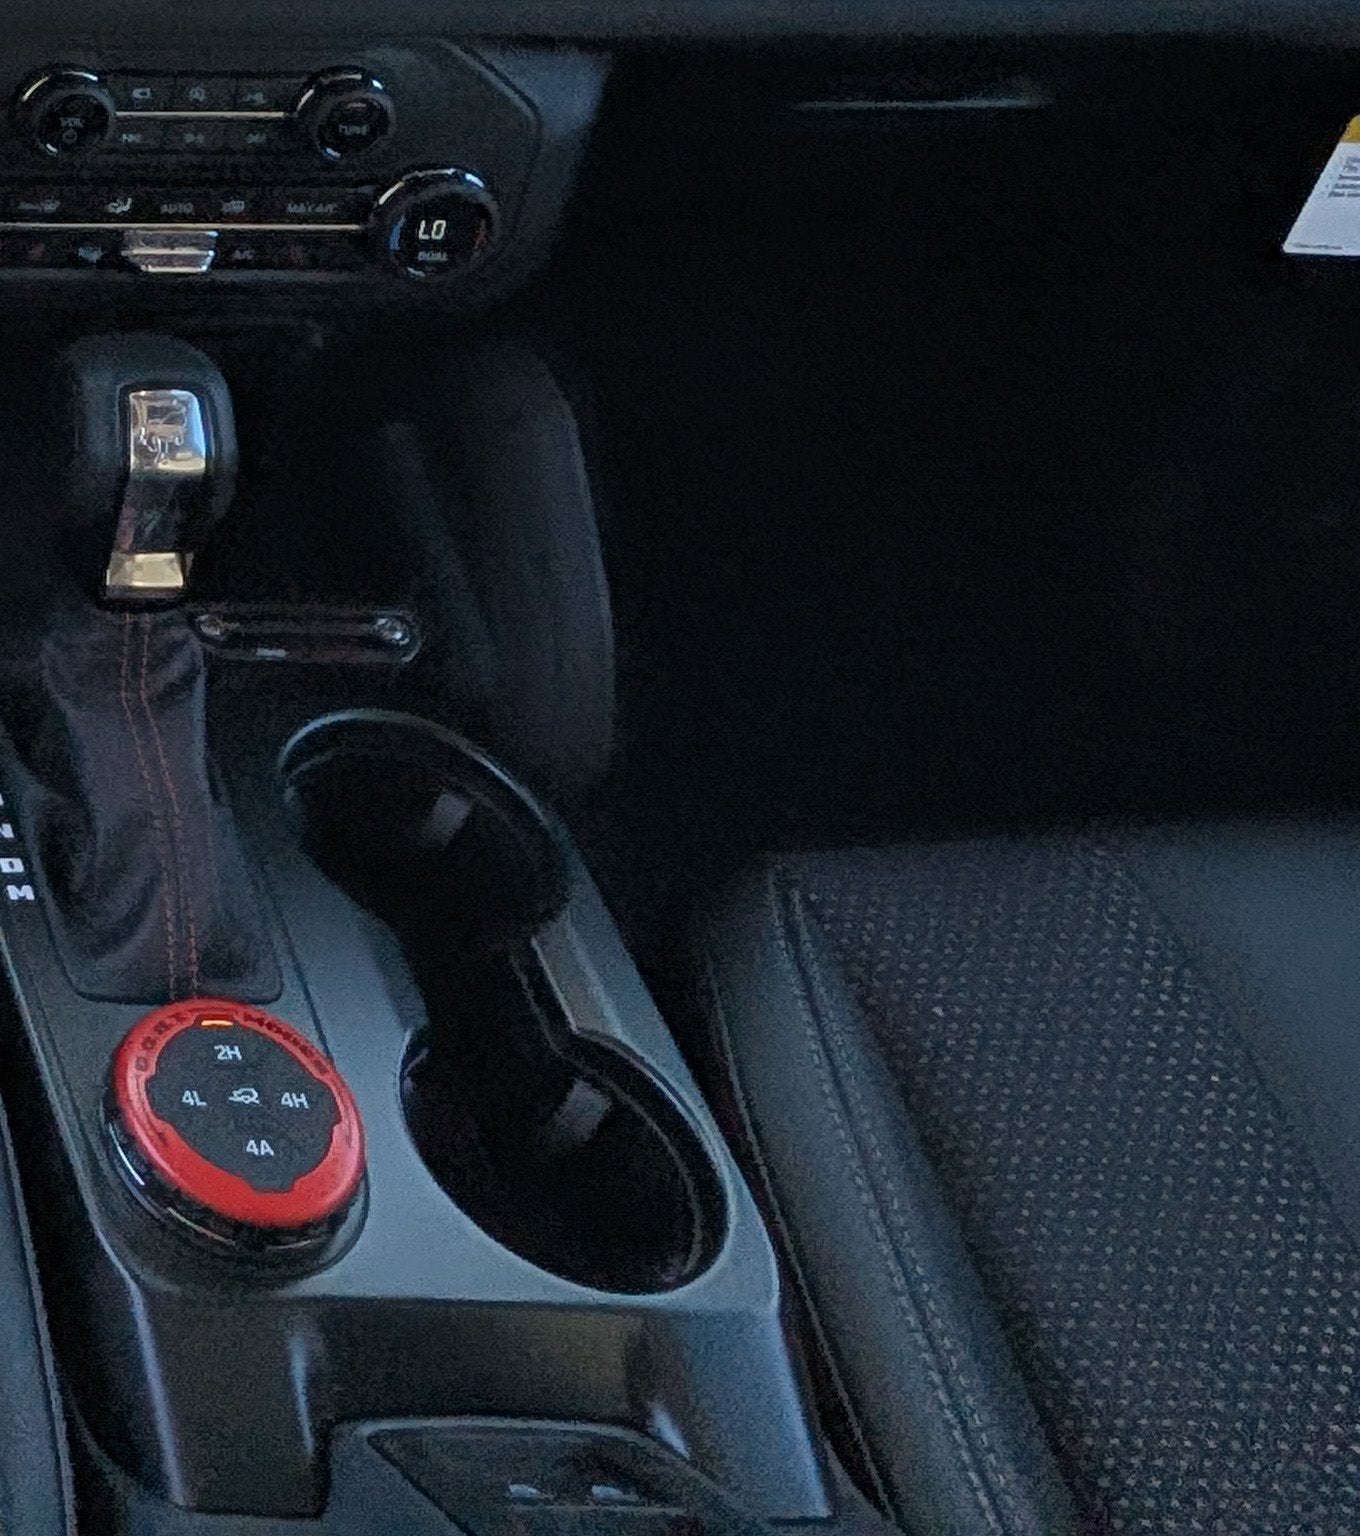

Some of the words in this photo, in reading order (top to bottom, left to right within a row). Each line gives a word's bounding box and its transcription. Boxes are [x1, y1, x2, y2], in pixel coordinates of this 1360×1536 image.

[418, 219, 447, 240] LO
[6, 884, 35, 901] M
[213, 1044, 242, 1061] 2H
[181, 1090, 207, 1106] 4L
[280, 1091, 309, 1109] 4H
[245, 1139, 274, 1156] 4A
